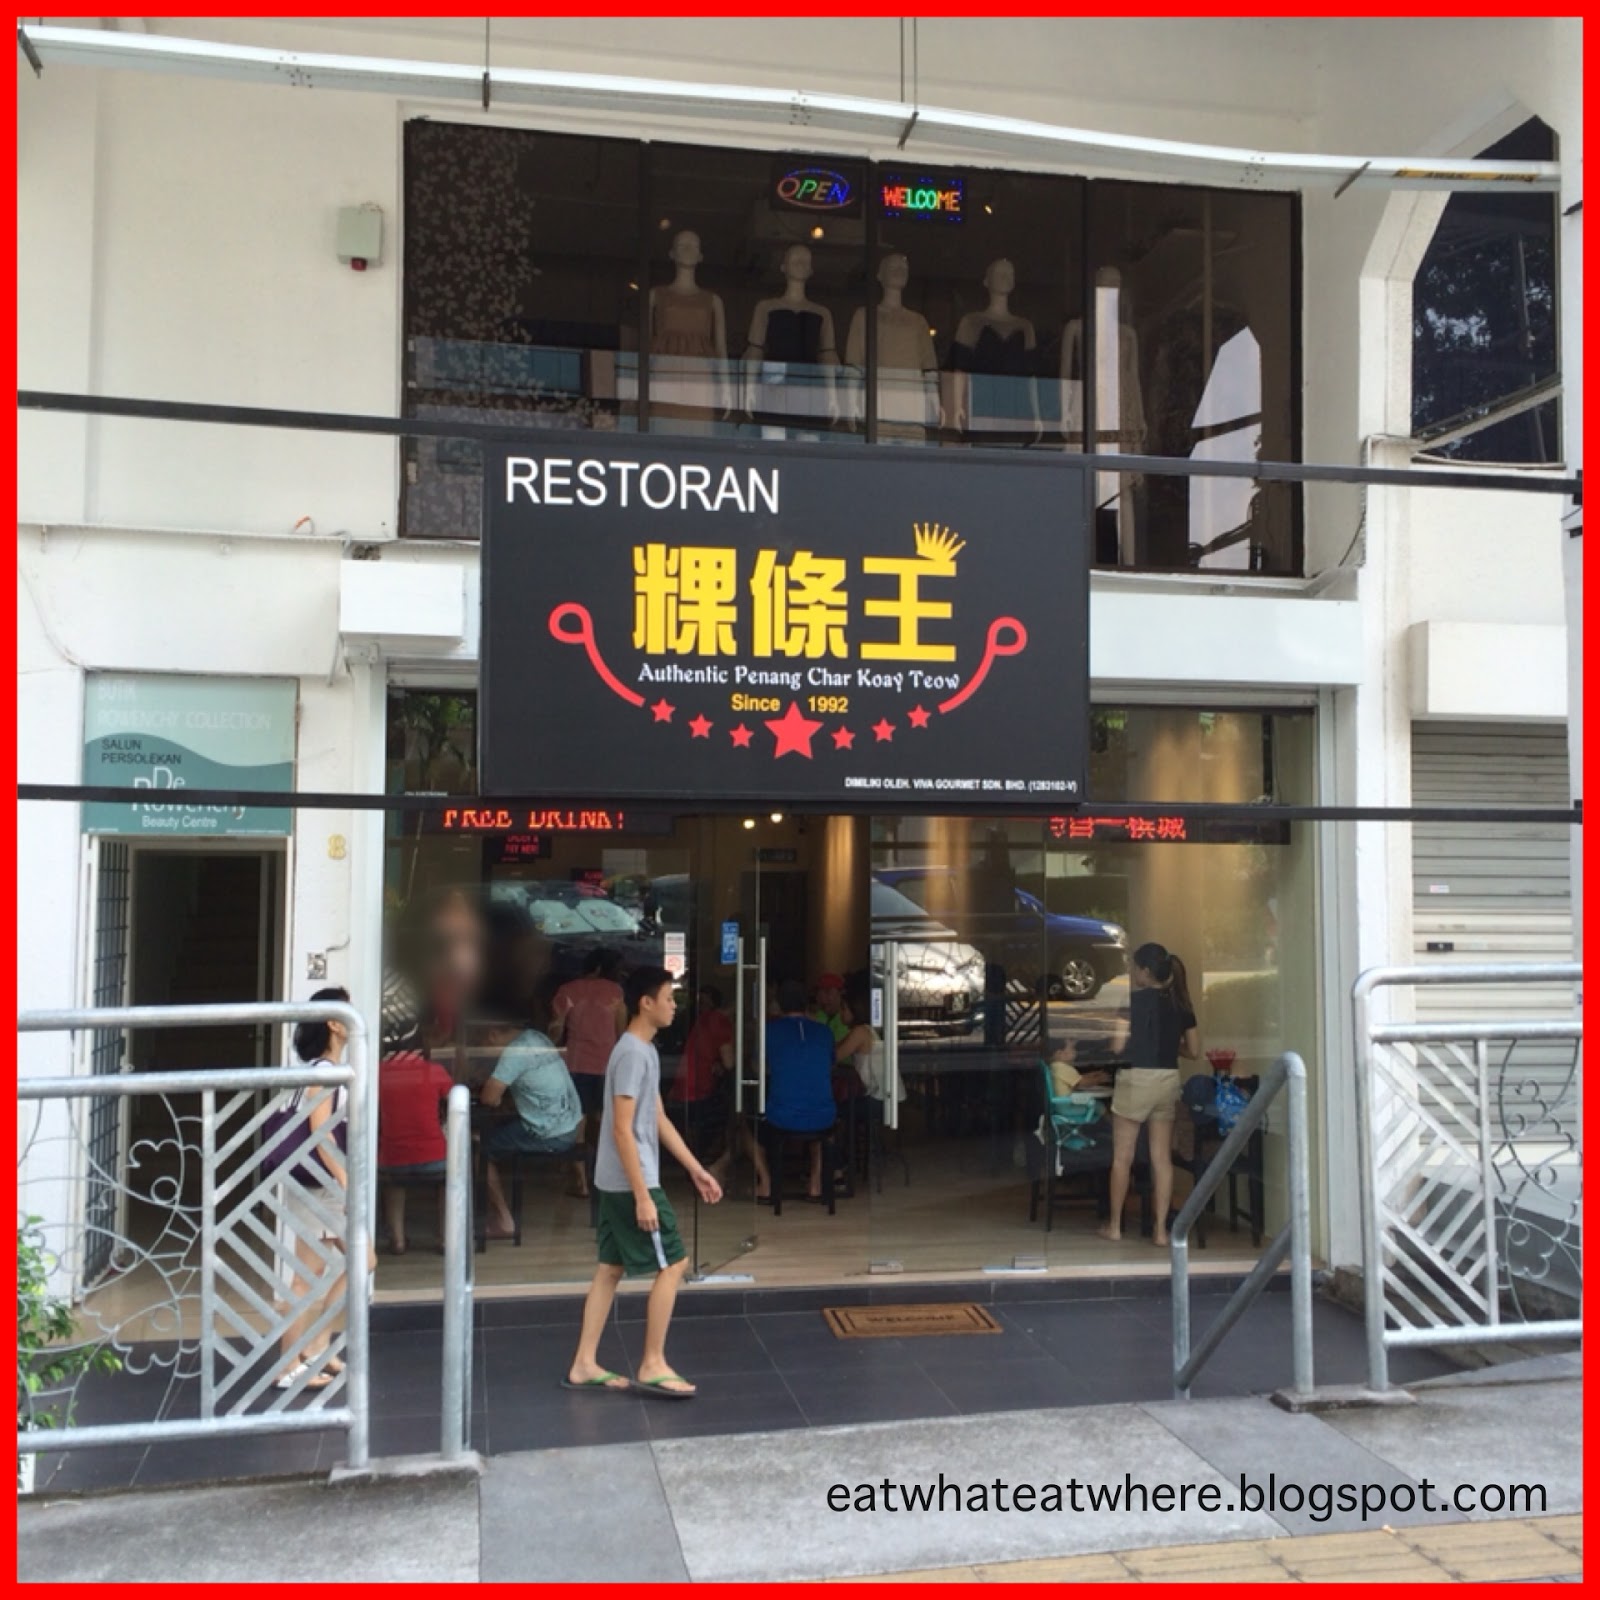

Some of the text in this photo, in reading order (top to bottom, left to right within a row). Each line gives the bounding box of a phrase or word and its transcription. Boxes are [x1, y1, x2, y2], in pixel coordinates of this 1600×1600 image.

[777, 177, 849, 204] OPEN
[883, 185, 961, 212] WELCOME
[506, 456, 780, 515] RESTORAN
[632, 542, 958, 662] 粿條王
[638, 663, 961, 693] Authentic Penang Char Koay Teow
[731, 694, 849, 714] Since 1992
[184, 711, 273, 730] COLLECTION
[101, 739, 142, 750] SALUN
[101, 752, 182, 765] PERSOLEKAN
[845, 776, 882, 788] DIMILIKI
[912, 778, 933, 789] VIVA
[935, 778, 980, 790] GOURMET
[142, 815, 218, 830] Beauty Centre
